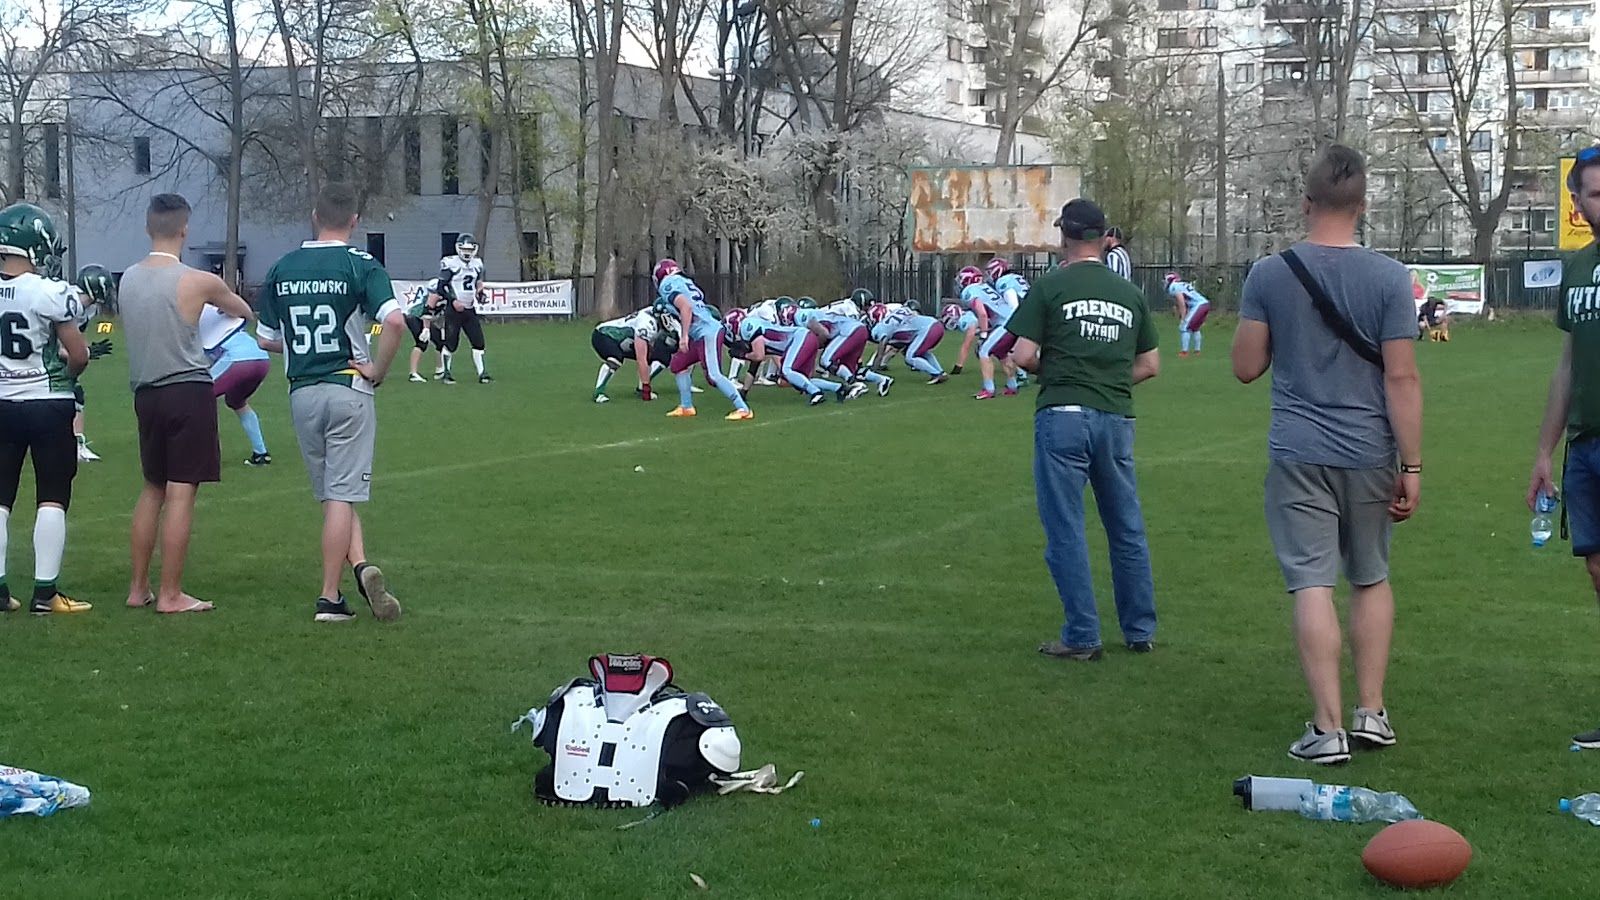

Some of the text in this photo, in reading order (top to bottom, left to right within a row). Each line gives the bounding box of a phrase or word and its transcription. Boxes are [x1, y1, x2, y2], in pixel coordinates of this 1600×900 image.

[276, 280, 347, 296] LEWIKOWSKI
[463, 275, 474, 290] 2
[511, 299, 567, 309] STEROWANIA
[1062, 299, 1134, 329] TRENER
[0, 311, 34, 360] 6
[289, 304, 340, 354] 52
[1080, 320, 1120, 341] TYTANI
